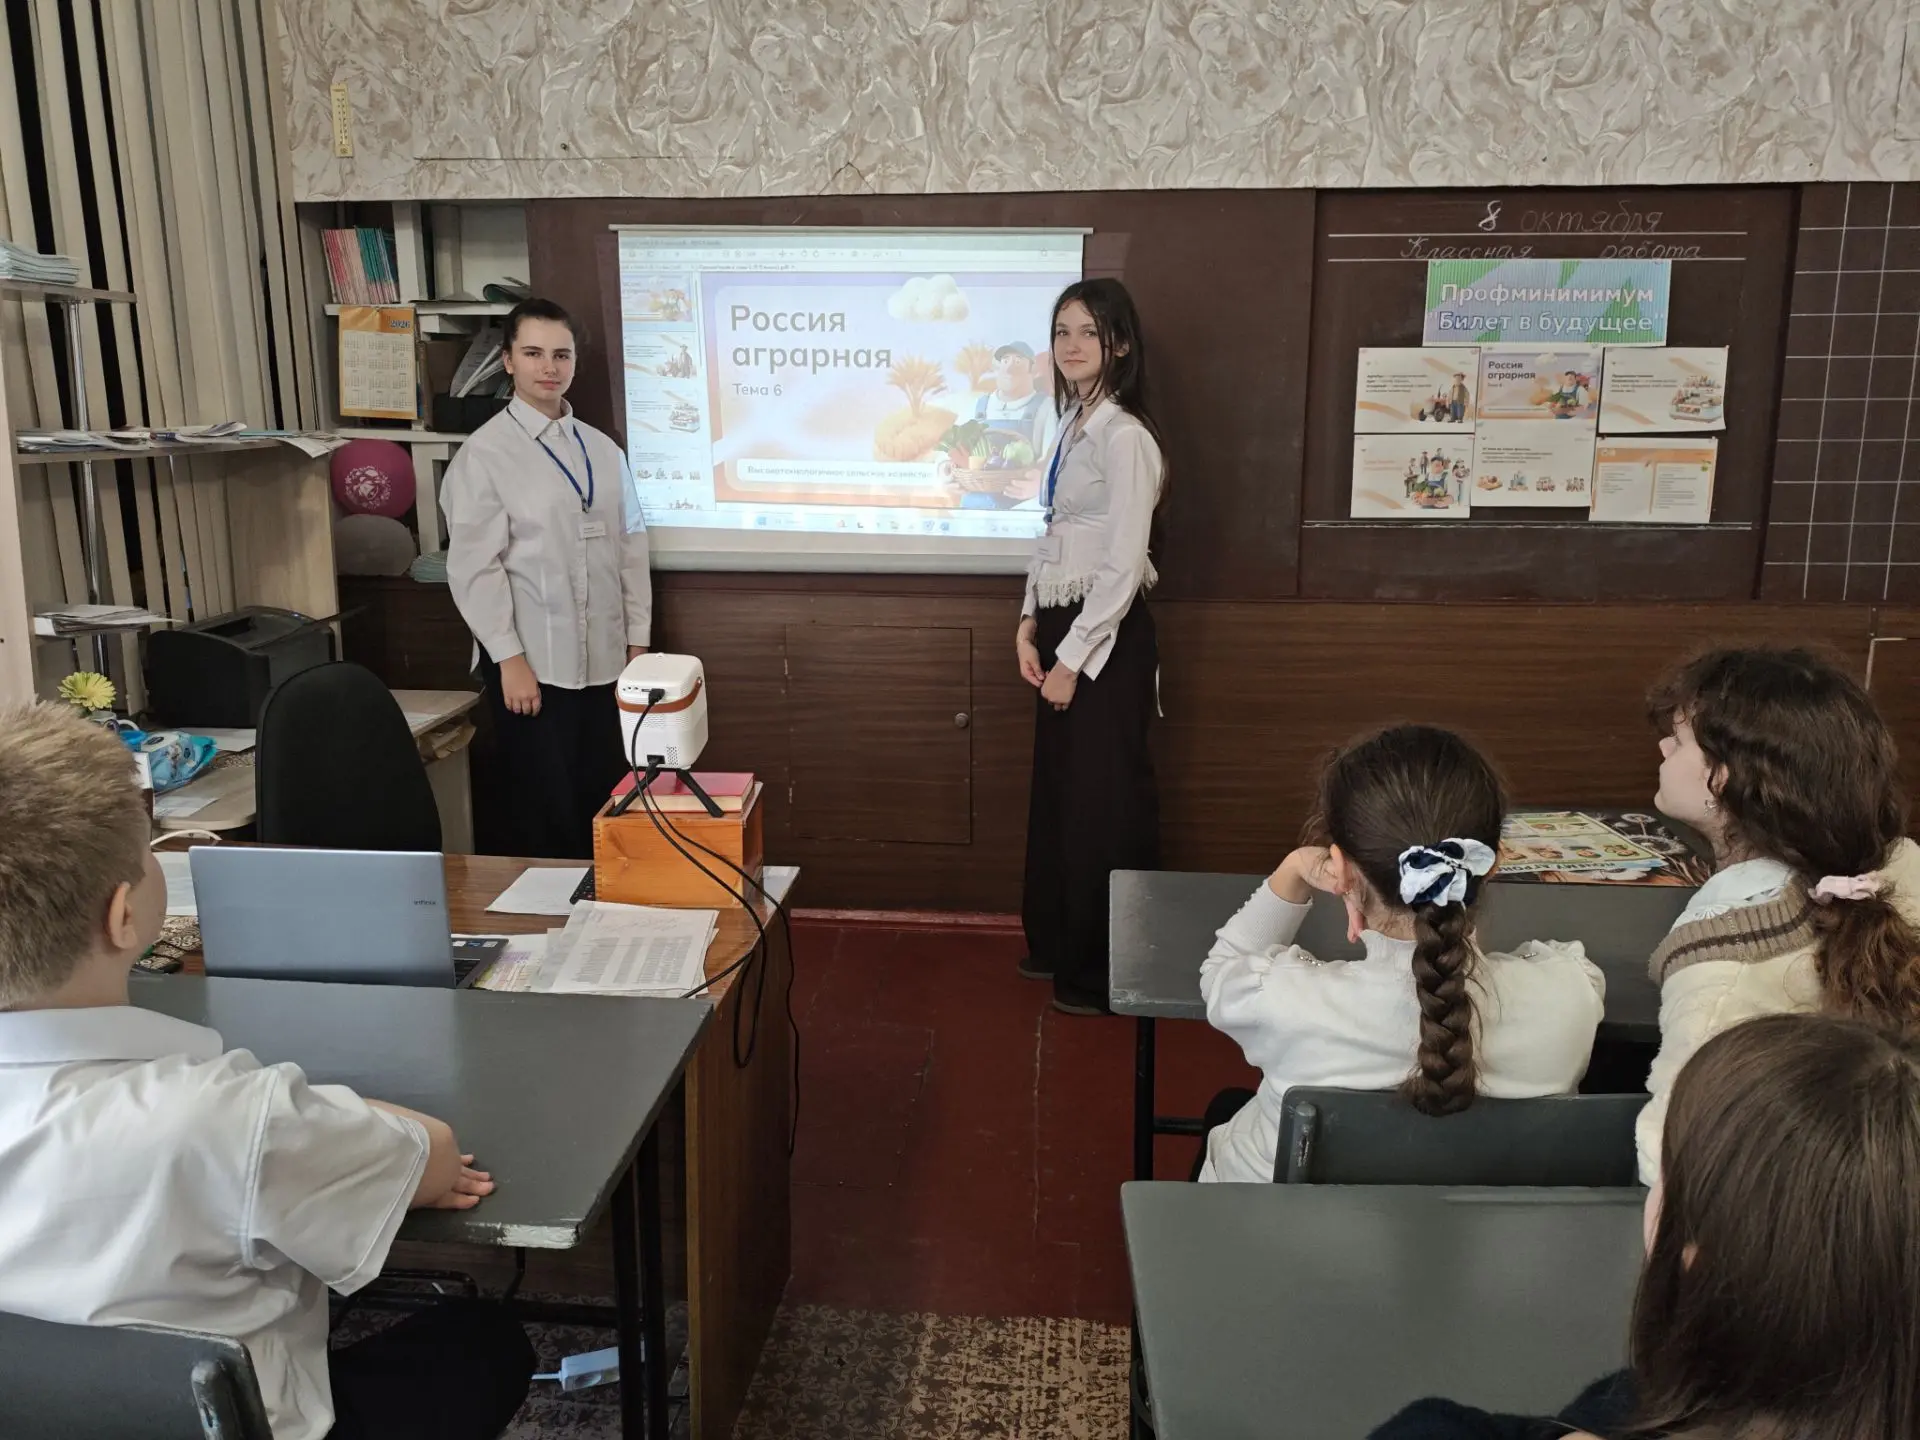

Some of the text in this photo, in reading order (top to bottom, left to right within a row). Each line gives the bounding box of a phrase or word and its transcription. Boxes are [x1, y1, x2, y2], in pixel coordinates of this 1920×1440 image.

[1477, 199, 1664, 241] 8 октября
[1400, 236, 1702, 259] Классная работа
[1441, 283, 1654, 307] Профминимимум
[731, 304, 846, 332] Россия
[1519, 313, 1531, 330] в
[732, 347, 892, 375] аграрная
[1488, 360, 1524, 370] Россия
[732, 383, 783, 397] Тема 6
